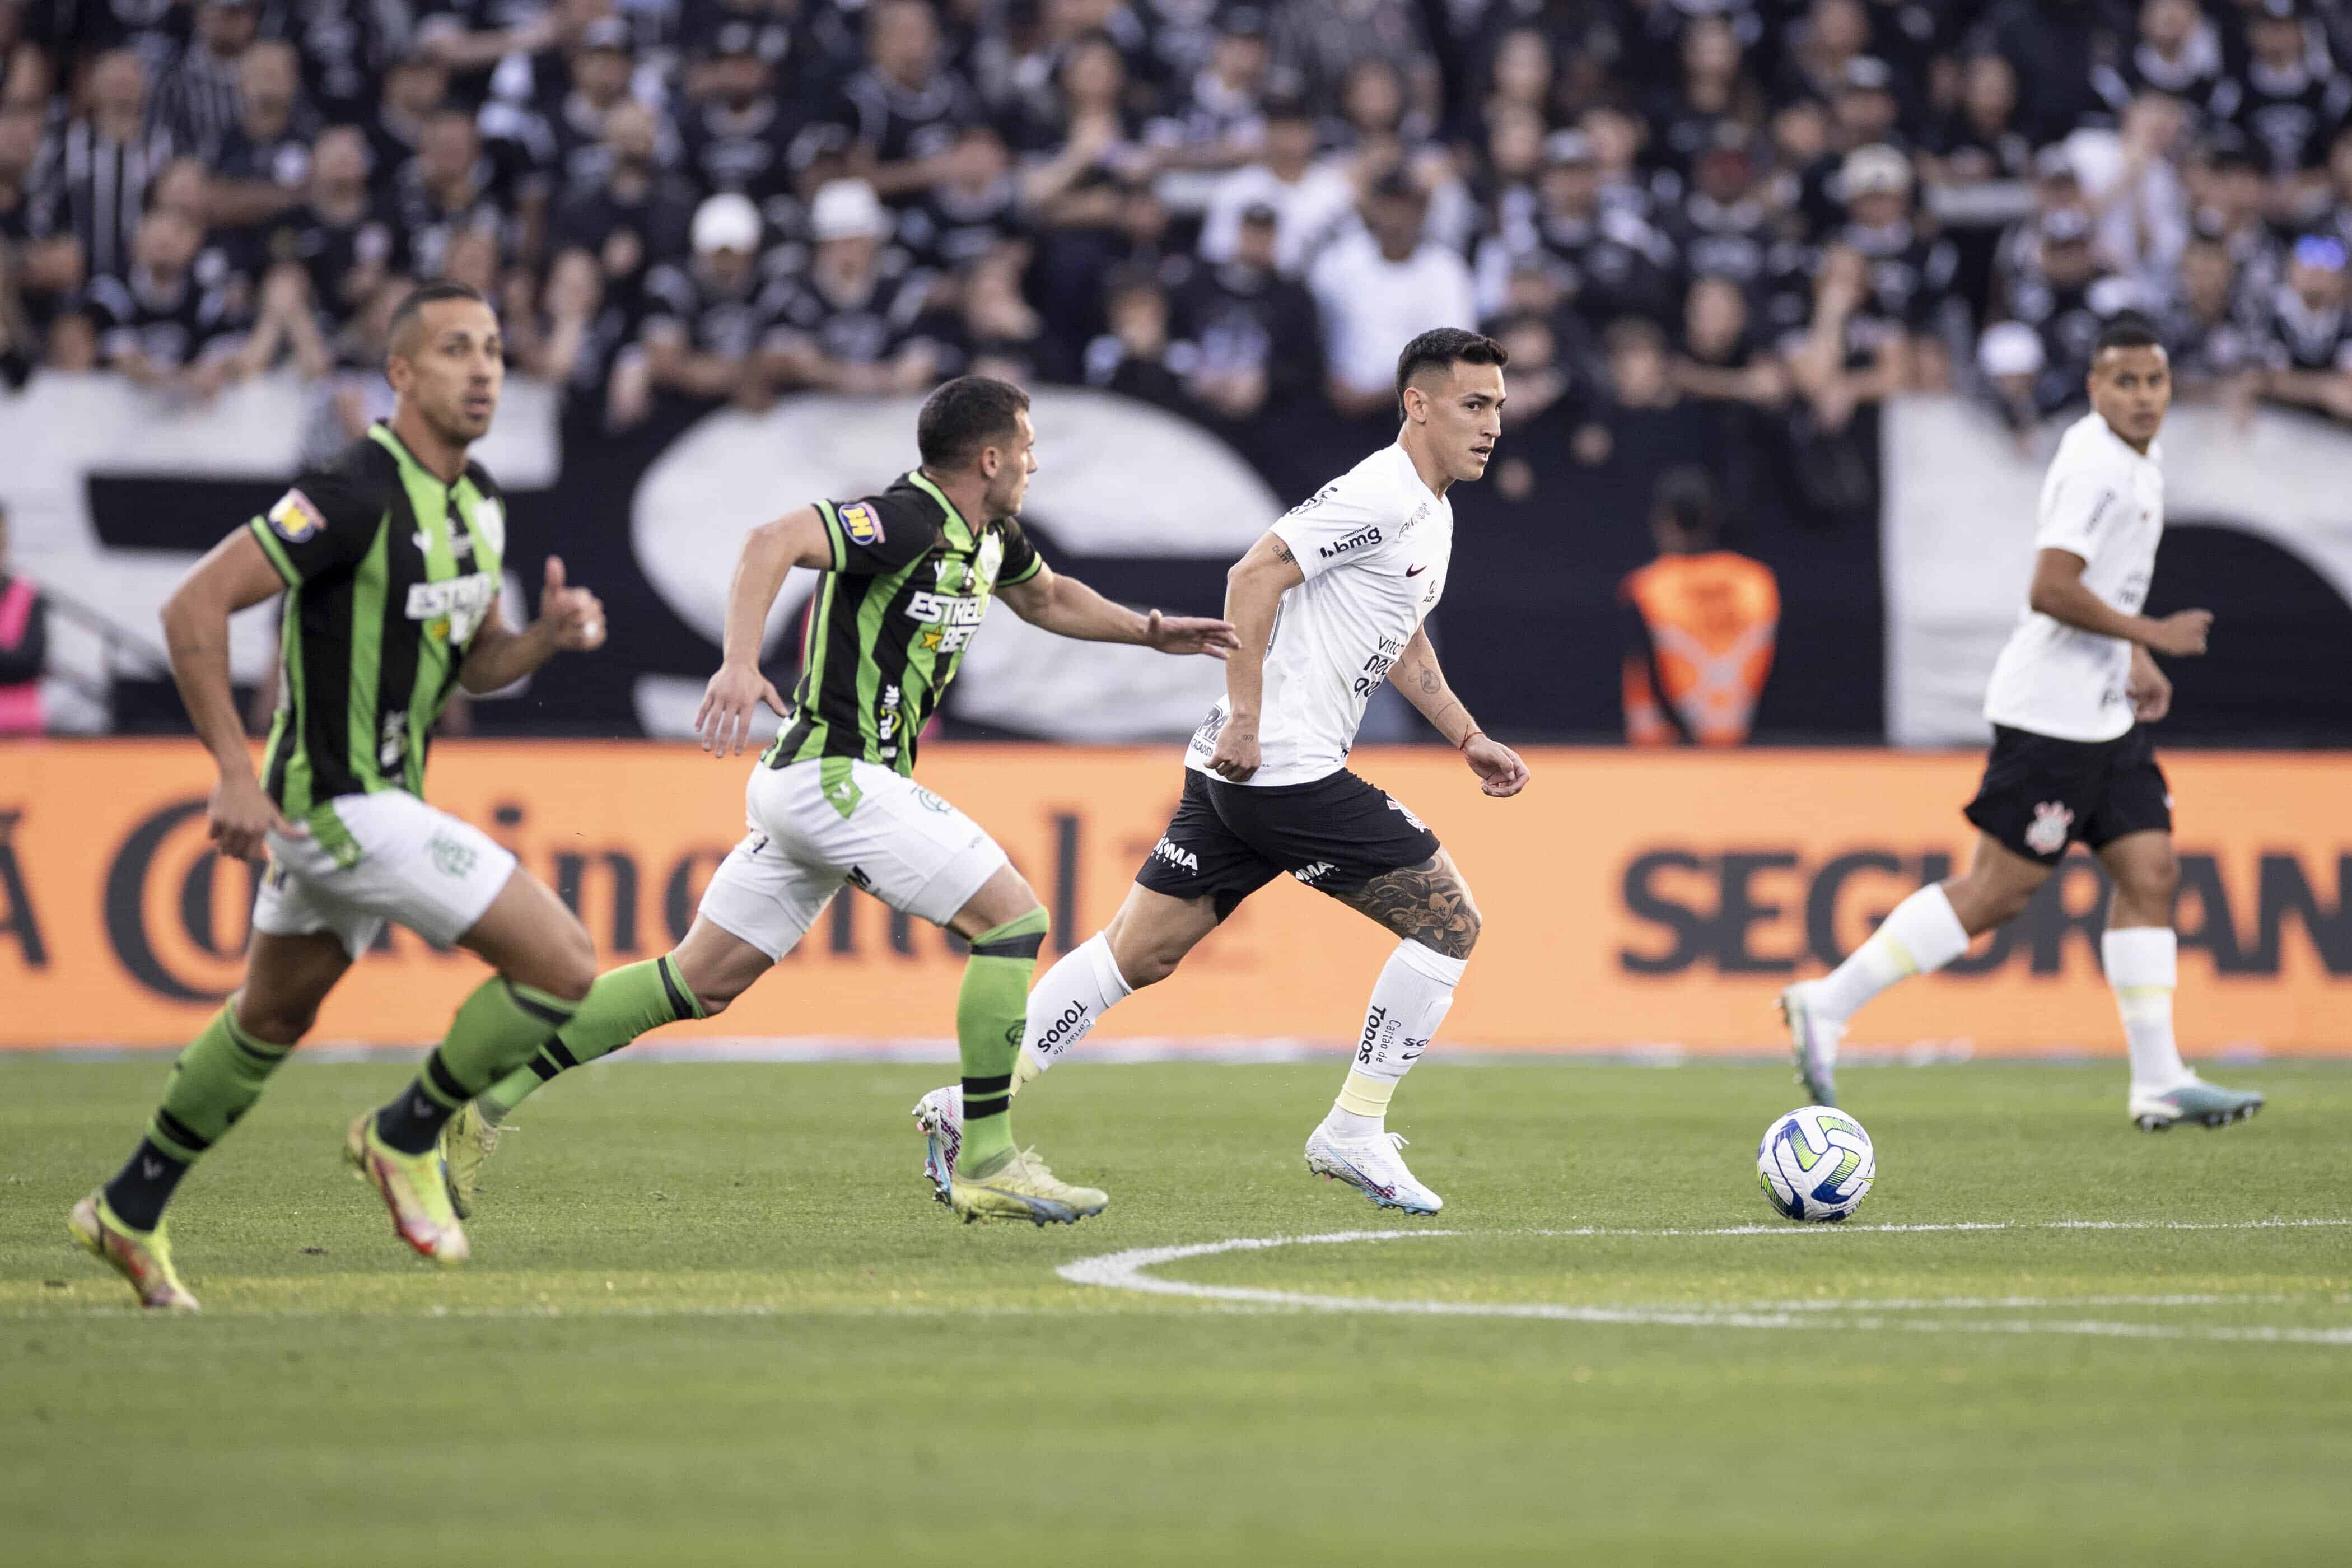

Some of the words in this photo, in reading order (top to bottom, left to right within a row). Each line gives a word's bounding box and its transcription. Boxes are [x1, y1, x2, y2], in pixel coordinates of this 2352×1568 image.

[1333, 527, 1382, 553] bmg
[904, 591, 991, 623] ESTREL
[1037, 1000, 1088, 1053] TODOS
[1359, 1005, 1387, 1065] TODOS
[1380, 1020, 1401, 1049] Cartão
[1376, 1052, 1387, 1063] de
